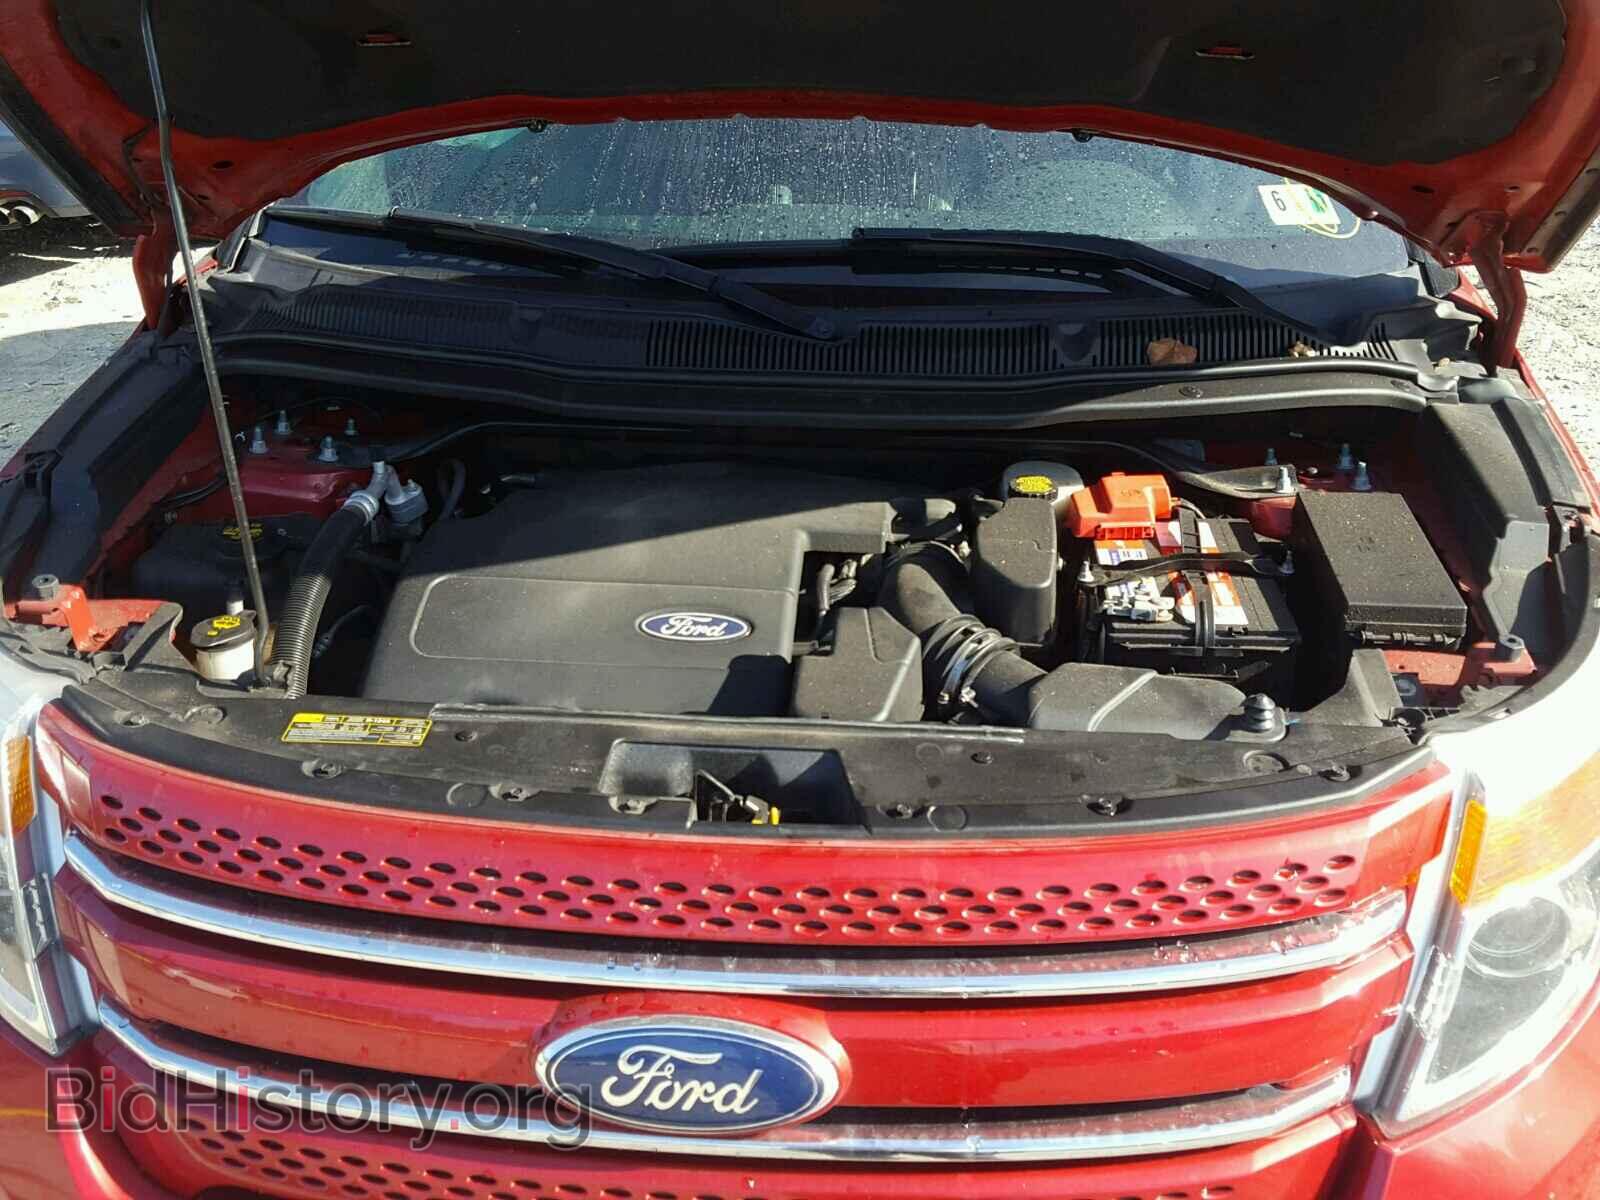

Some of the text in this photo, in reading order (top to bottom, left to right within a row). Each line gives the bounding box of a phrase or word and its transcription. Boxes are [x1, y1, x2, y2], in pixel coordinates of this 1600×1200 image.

[1270, 190, 1287, 212] 6
[660, 615, 729, 637] Ford
[601, 1044, 764, 1115] Ford
